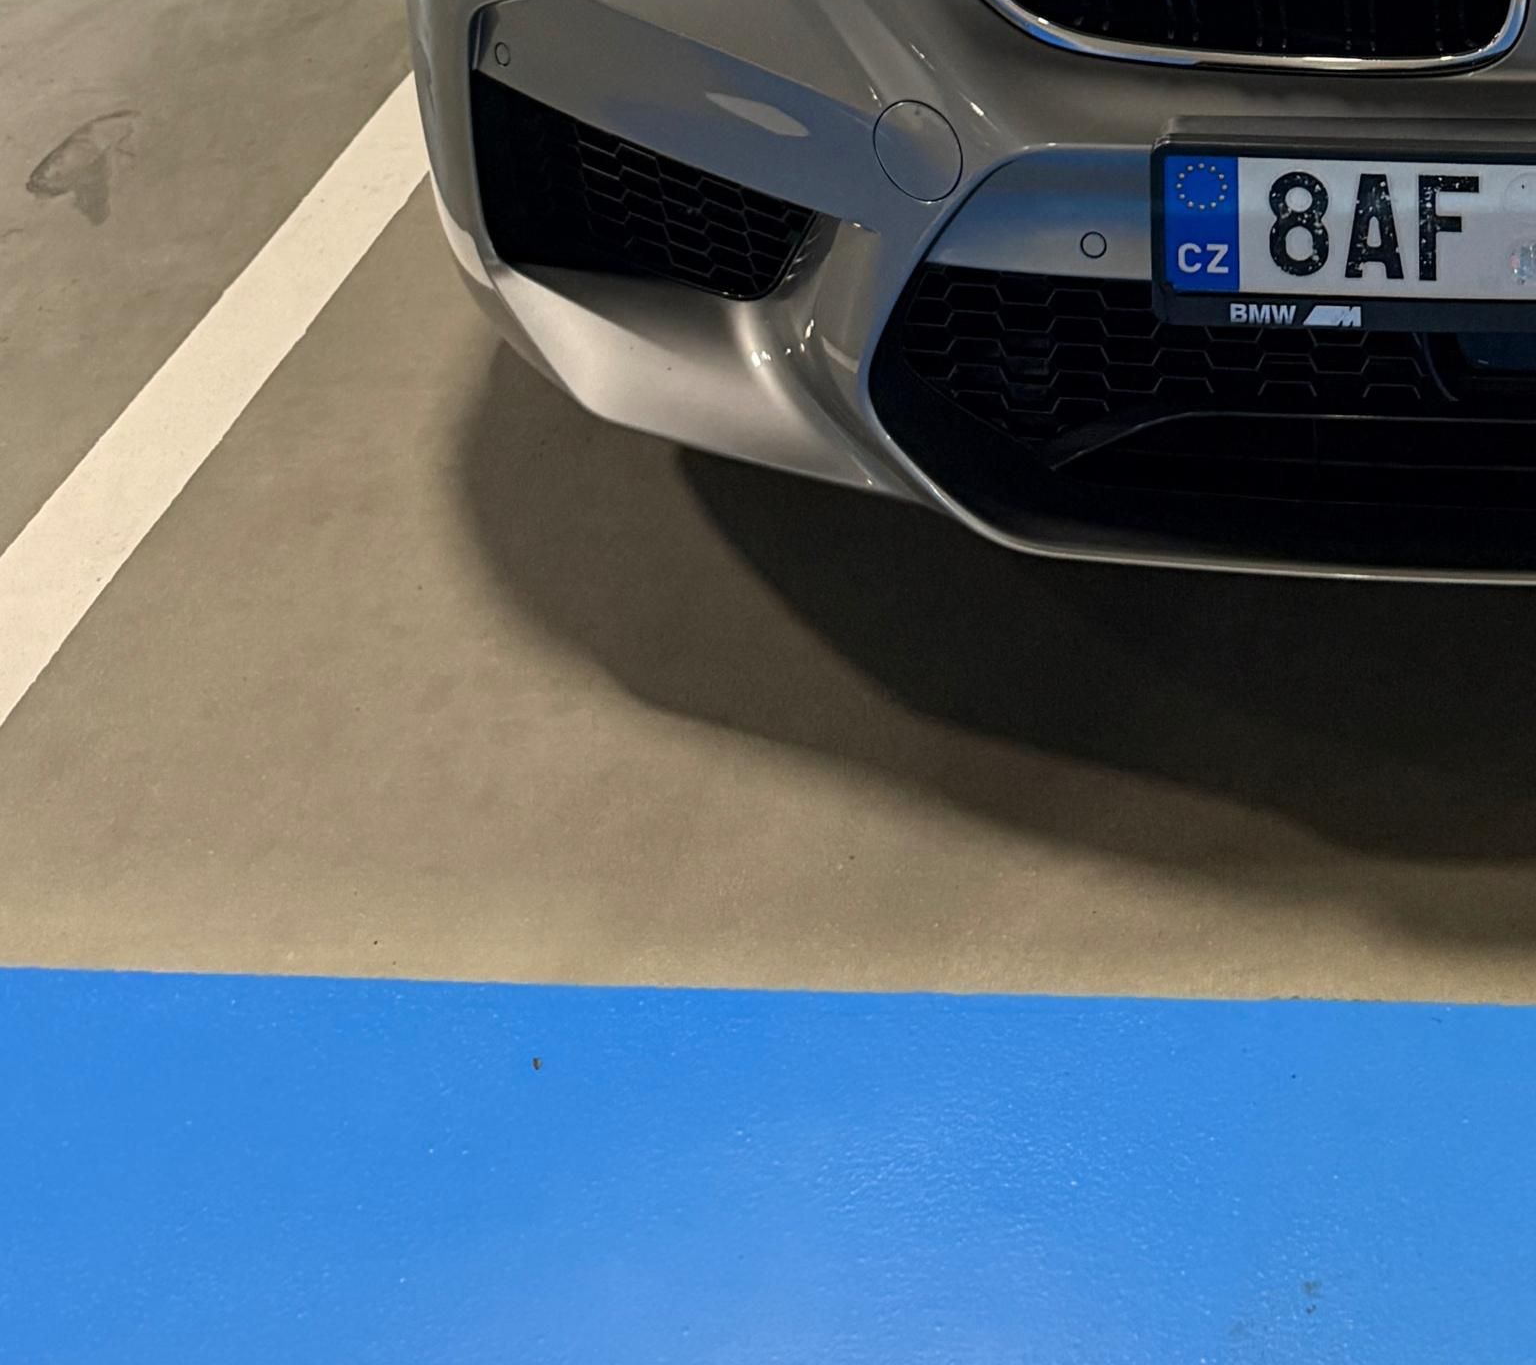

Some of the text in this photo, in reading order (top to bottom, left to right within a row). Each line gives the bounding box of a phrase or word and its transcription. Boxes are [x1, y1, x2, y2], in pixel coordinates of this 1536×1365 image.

[1267, 171, 1480, 281] 8AF
[1177, 242, 1230, 275] CZ
[1229, 302, 1297, 325] BMW
